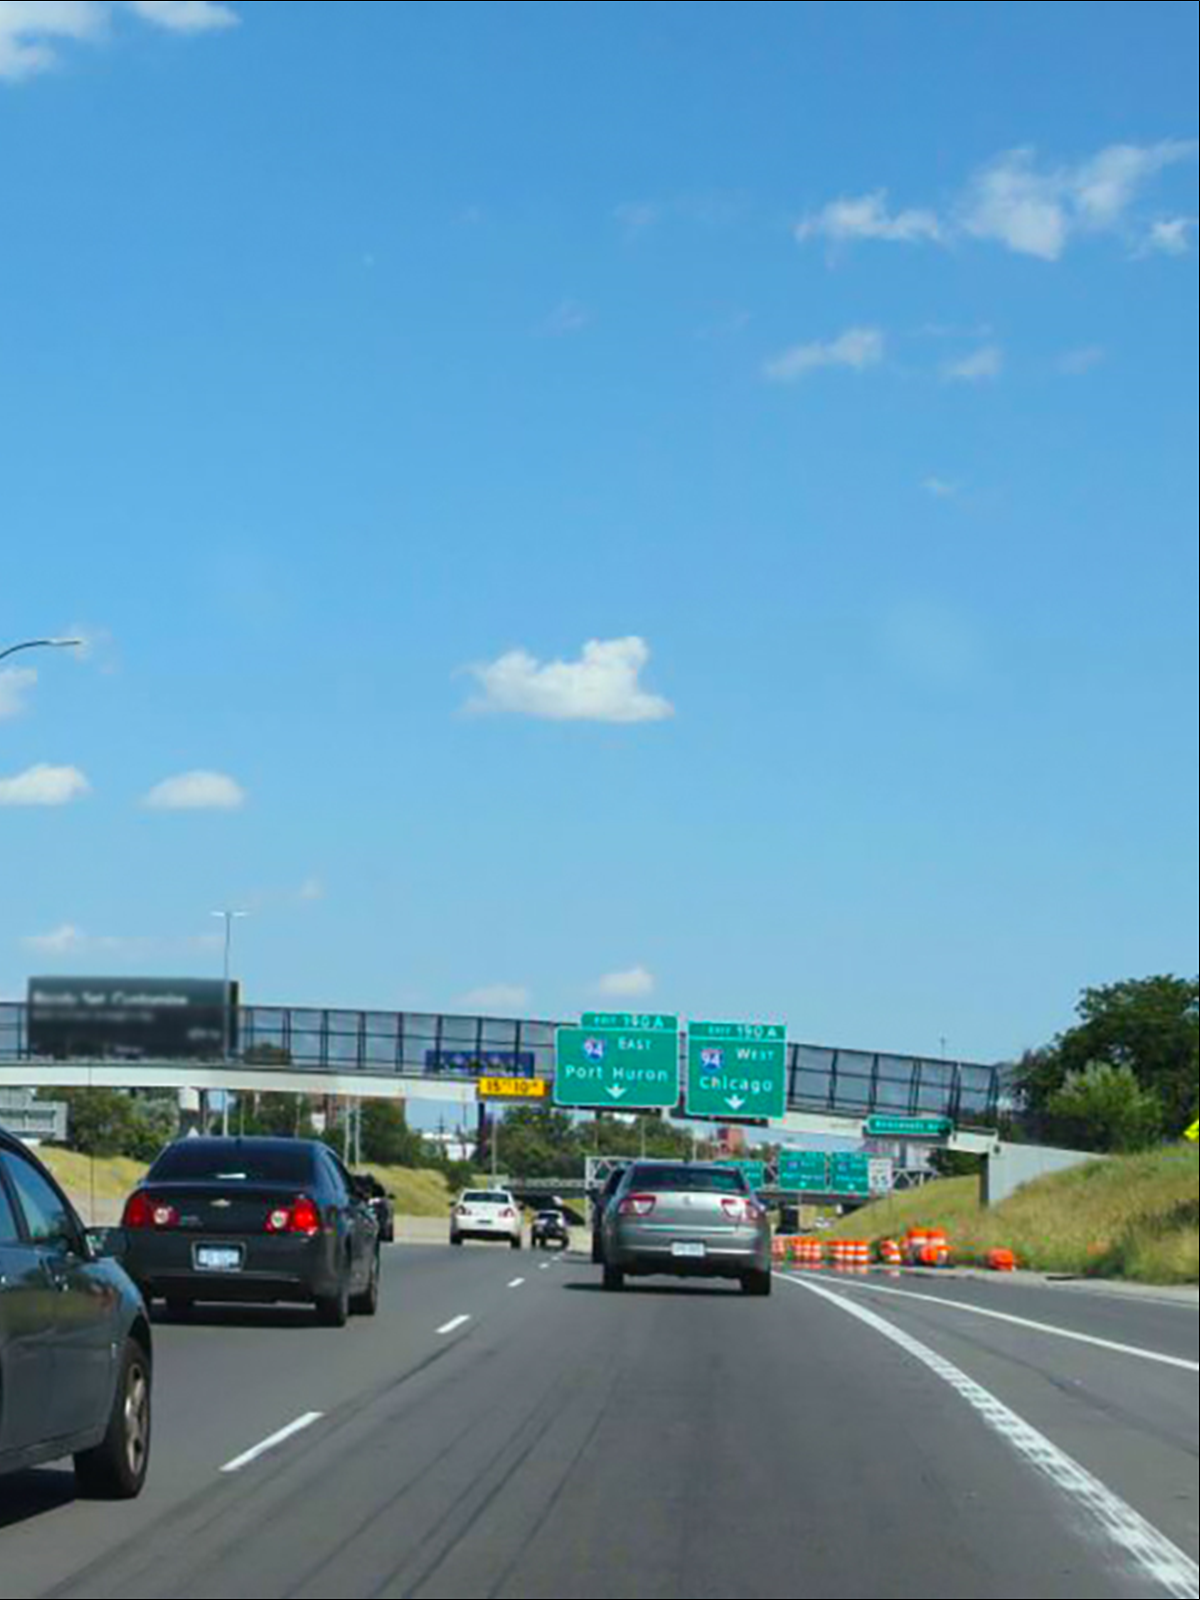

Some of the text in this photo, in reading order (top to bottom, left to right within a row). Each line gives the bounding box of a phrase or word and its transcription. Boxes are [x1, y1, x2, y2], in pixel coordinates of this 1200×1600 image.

[653, 1015, 665, 1028] A
[766, 1025, 778, 1038] A
[584, 1036, 652, 1058] 94 EAST
[701, 1047, 775, 1069] 94 WEST
[564, 1064, 669, 1083] Port Huron
[699, 1075, 773, 1096] Chicago
